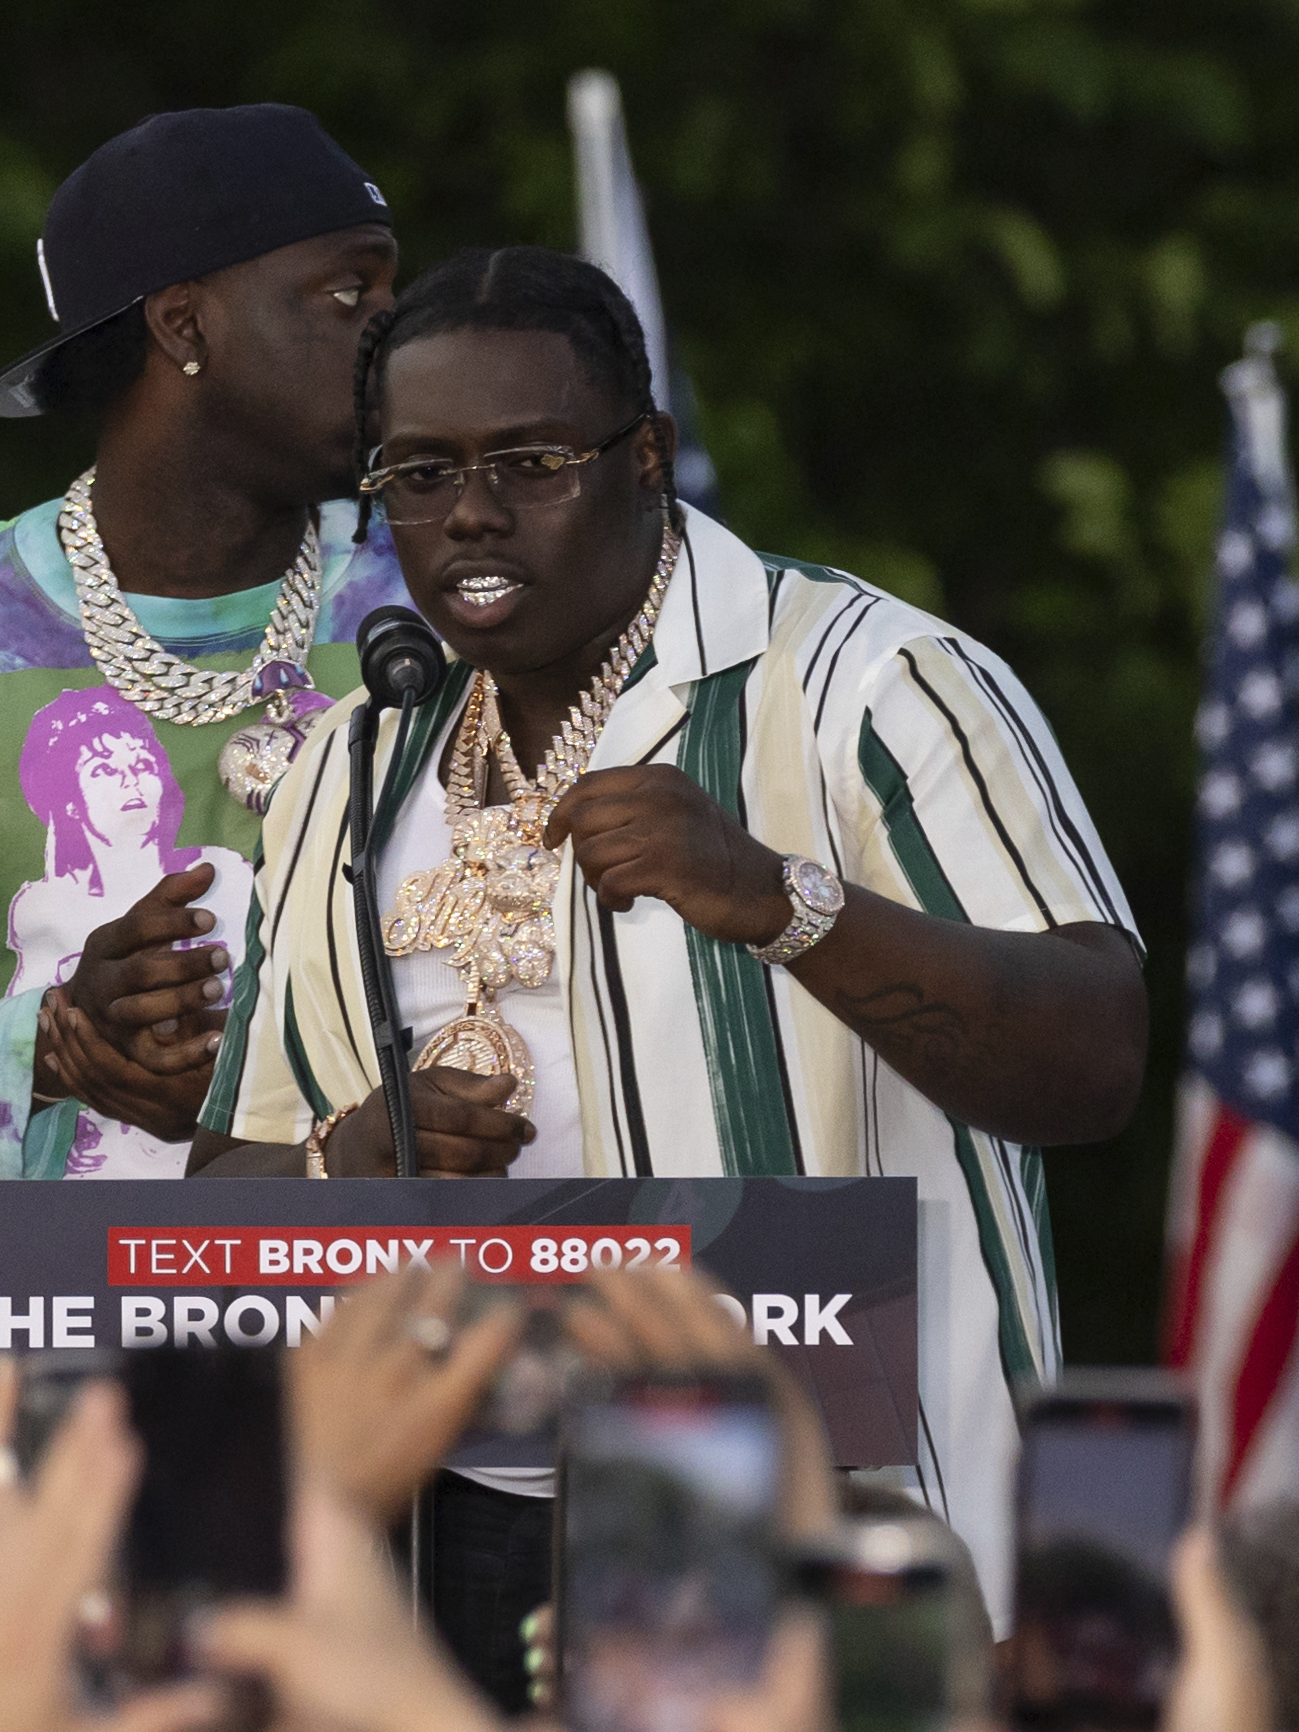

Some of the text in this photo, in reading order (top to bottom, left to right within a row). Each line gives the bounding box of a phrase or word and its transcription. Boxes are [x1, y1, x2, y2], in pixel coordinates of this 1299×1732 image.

[118, 1237, 681, 1275] TEXT BRONX TO 88022
[121, 1295, 351, 1348] BRON
